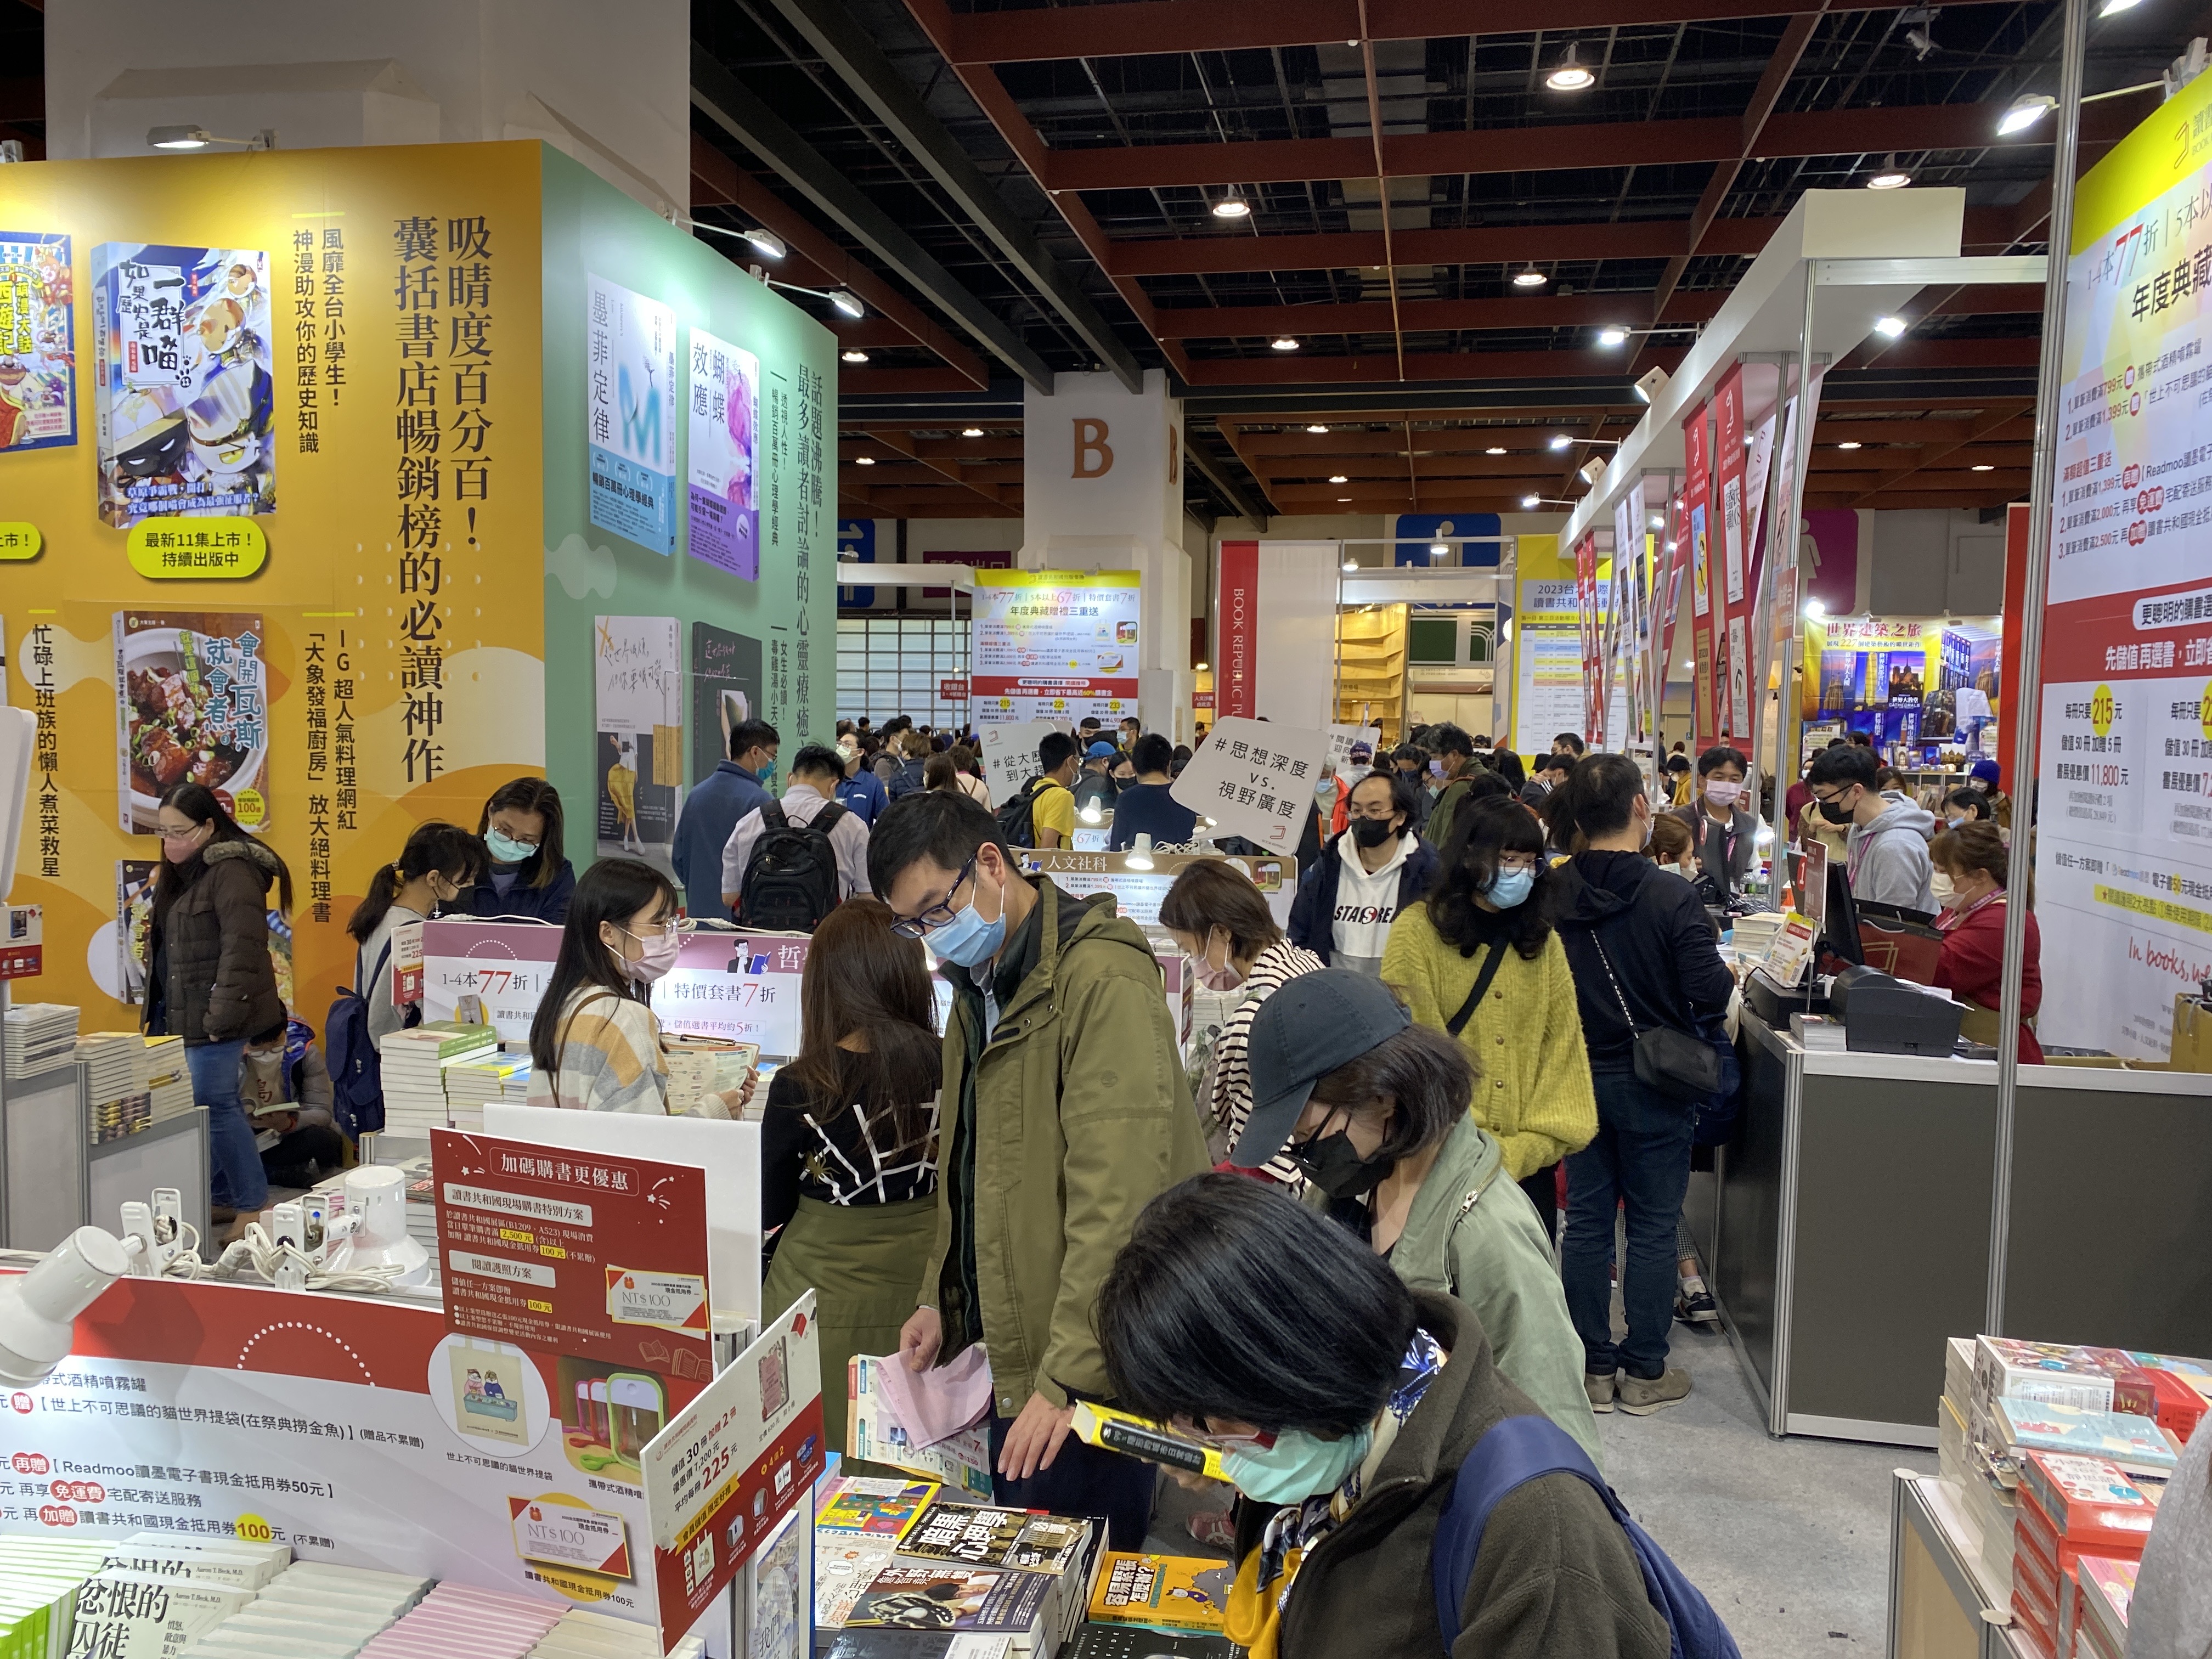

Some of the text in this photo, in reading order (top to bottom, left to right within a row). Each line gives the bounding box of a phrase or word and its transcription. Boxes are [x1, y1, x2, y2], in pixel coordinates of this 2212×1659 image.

[2131, 243, 2212, 323] 年度典藏
[321, 228, 346, 407] 風靡全台小學生！
[292, 229, 319, 454] 神漫助攻你的歷史知識
[447, 216, 493, 545] 吸睛度百分百！
[592, 289, 610, 443] 墨菲定律
[692, 342, 708, 416] 效應
[713, 349, 725, 425] 蝴蝶
[811, 370, 822, 537] 話題沸騰！
[1071, 418, 1114, 478] B
[1169, 424, 1178, 485] B
[393, 216, 445, 783] 囊括書店暢銷榜的必讀神作
[145, 532, 252, 549] 最新11集上市！
[162, 551, 239, 568] 持續出版中
[797, 363, 810, 748] 最多讀者討論的心靈療癒
[1010, 606, 1099, 617] 年度典藏贈禮三重送
[1030, 591, 1080, 604] 5本以上67折
[1089, 592, 1136, 605] 特價套書7折
[1232, 588, 1244, 698] BOOK REPUBLIC
[1827, 622, 1922, 638] 世界建築之旅
[204, 637, 233, 731] 就會煮
[229, 631, 263, 752] 會開瓦斯
[1000, 699, 1011, 707] 215
[1053, 700, 1065, 708] 225
[1109, 701, 1120, 709] 233
[2092, 698, 2113, 725] 215
[31, 623, 60, 878] 忙碌上班族的懶人煮菜救星
[332, 678, 357, 830] 超人氣料理網紅
[1230, 741, 1308, 779] 思想深度
[2091, 764, 2119, 786] 11,800
[1218, 780, 1296, 820] 視野廣度
[308, 793, 331, 924] 放大絕料理書
[1047, 856, 1107, 872] 人文社科
[2129, 936, 2189, 983] In books,
[443, 970, 527, 994] 1-4本77折
[674, 983, 776, 1007] 特價套書7折
[500, 1153, 629, 1190] 加碼購書更優惠
[452, 1189, 584, 1221] 讀書共和國現場購書特別方案
[562, 1229, 594, 1243] 現場消費
[452, 1277, 511, 1294] 儲值任一方案即贈
[472, 1259, 532, 1279] 閱讀護照方案
[14, 1453, 48, 1472] 再贈
[671, 1456, 685, 1478] 儲值
[686, 1440, 699, 1463] 30
[723, 1413, 729, 1427] 2
[446, 1452, 554, 1482] 世上不可思議的貓世界提袋
[672, 1471, 693, 1496] 優惠價
[693, 1449, 712, 1477] 7,200
[674, 1481, 701, 1513] 平均每冊
[702, 1446, 729, 1490] 225
[19, 1482, 202, 1508] 再享 免運費 宅配寄送服務
[682, 1483, 731, 1543] 會員儲值 限定好禮
[43, 1508, 75, 1525] 加贈
[293, 1533, 335, 1550] (不累贈)
[917, 1513, 972, 1546] 暗黑
[950, 1509, 1008, 1561] 心理學
[77, 1577, 170, 1624] 忿恨的
[174, 1592, 190, 1600] Aaron
[524, 1570, 634, 1609] 讀書共和國現金抵用券100元
[1104, 1559, 1138, 1606] 容易緊張
